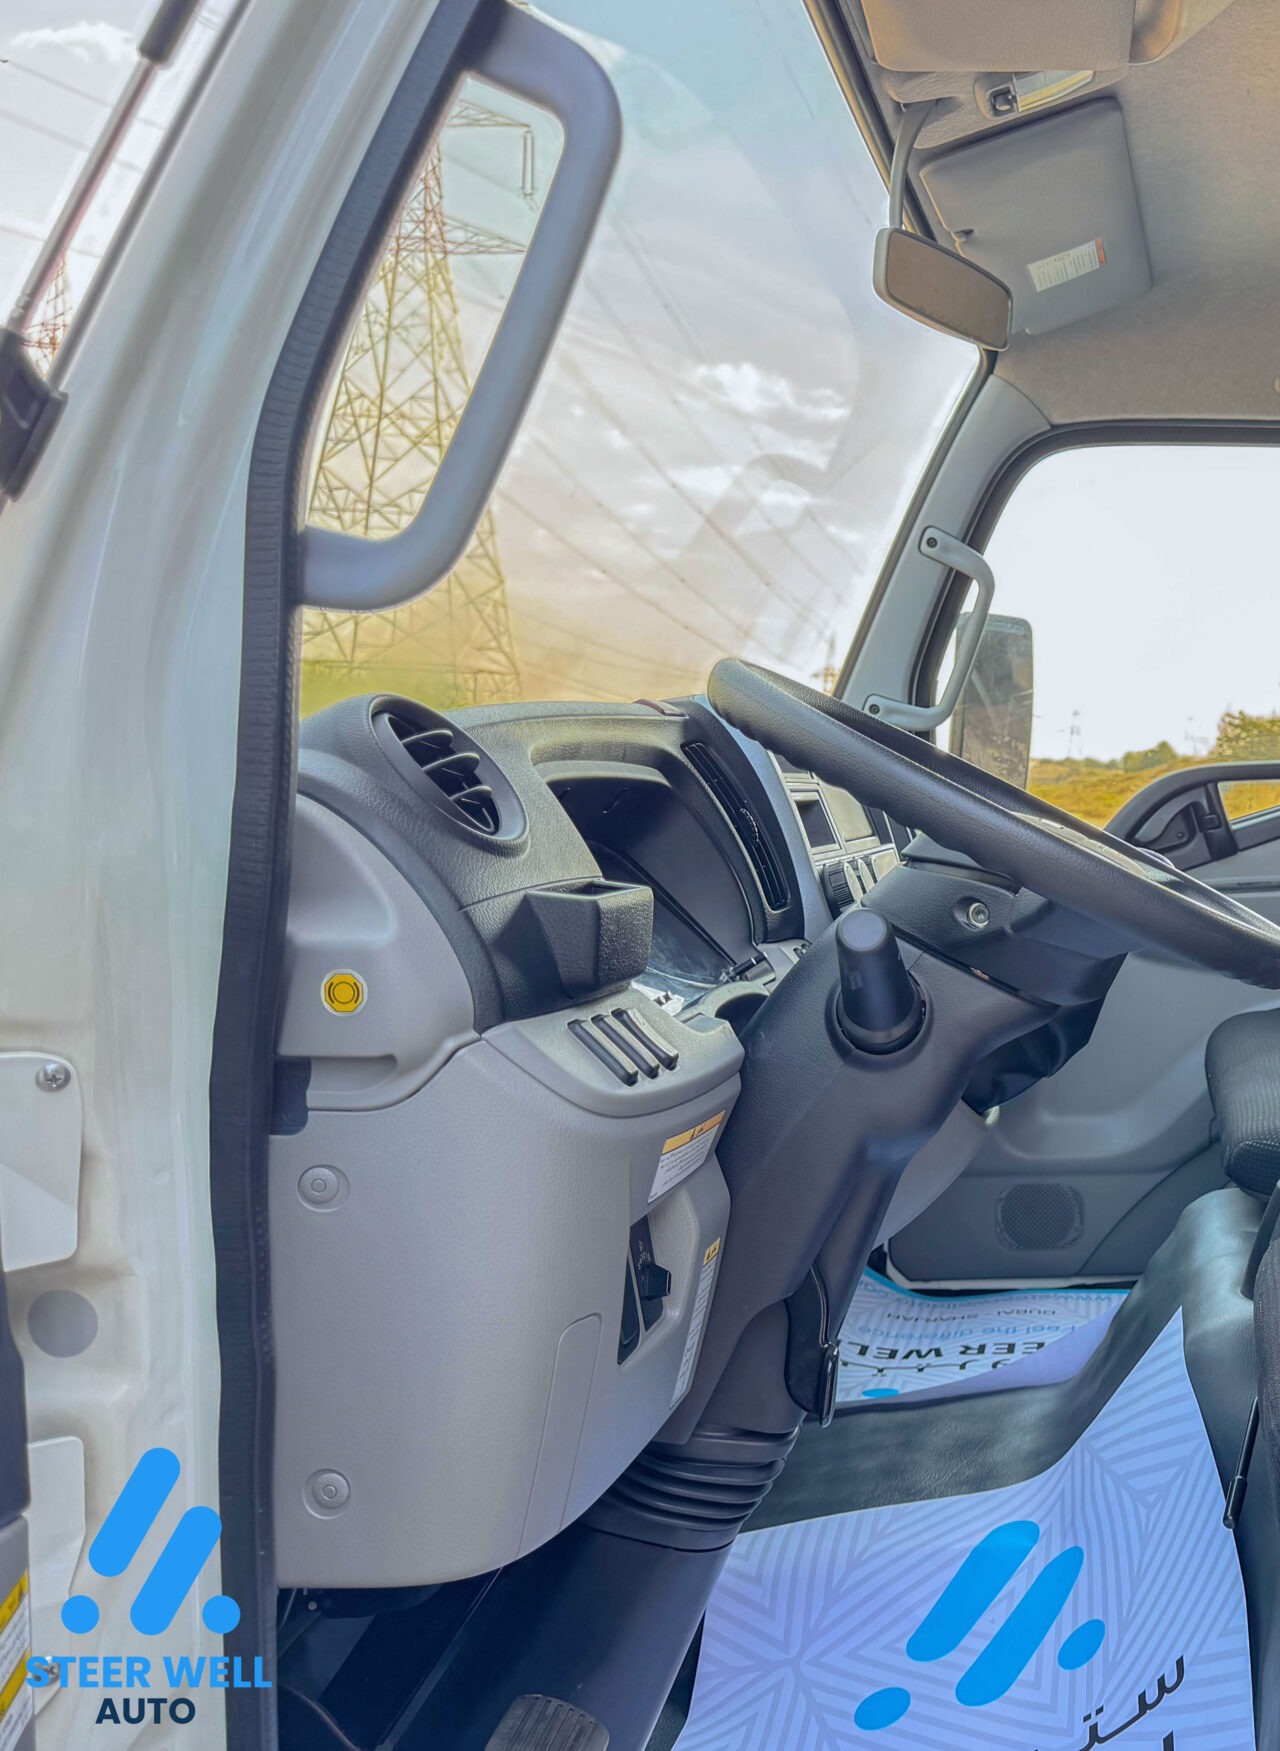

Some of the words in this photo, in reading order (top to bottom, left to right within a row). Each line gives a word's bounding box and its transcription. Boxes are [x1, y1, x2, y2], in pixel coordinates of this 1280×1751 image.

[857, 1325, 974, 1340] difference
[982, 1325, 1017, 1336] the
[958, 1341, 1046, 1356] EER
